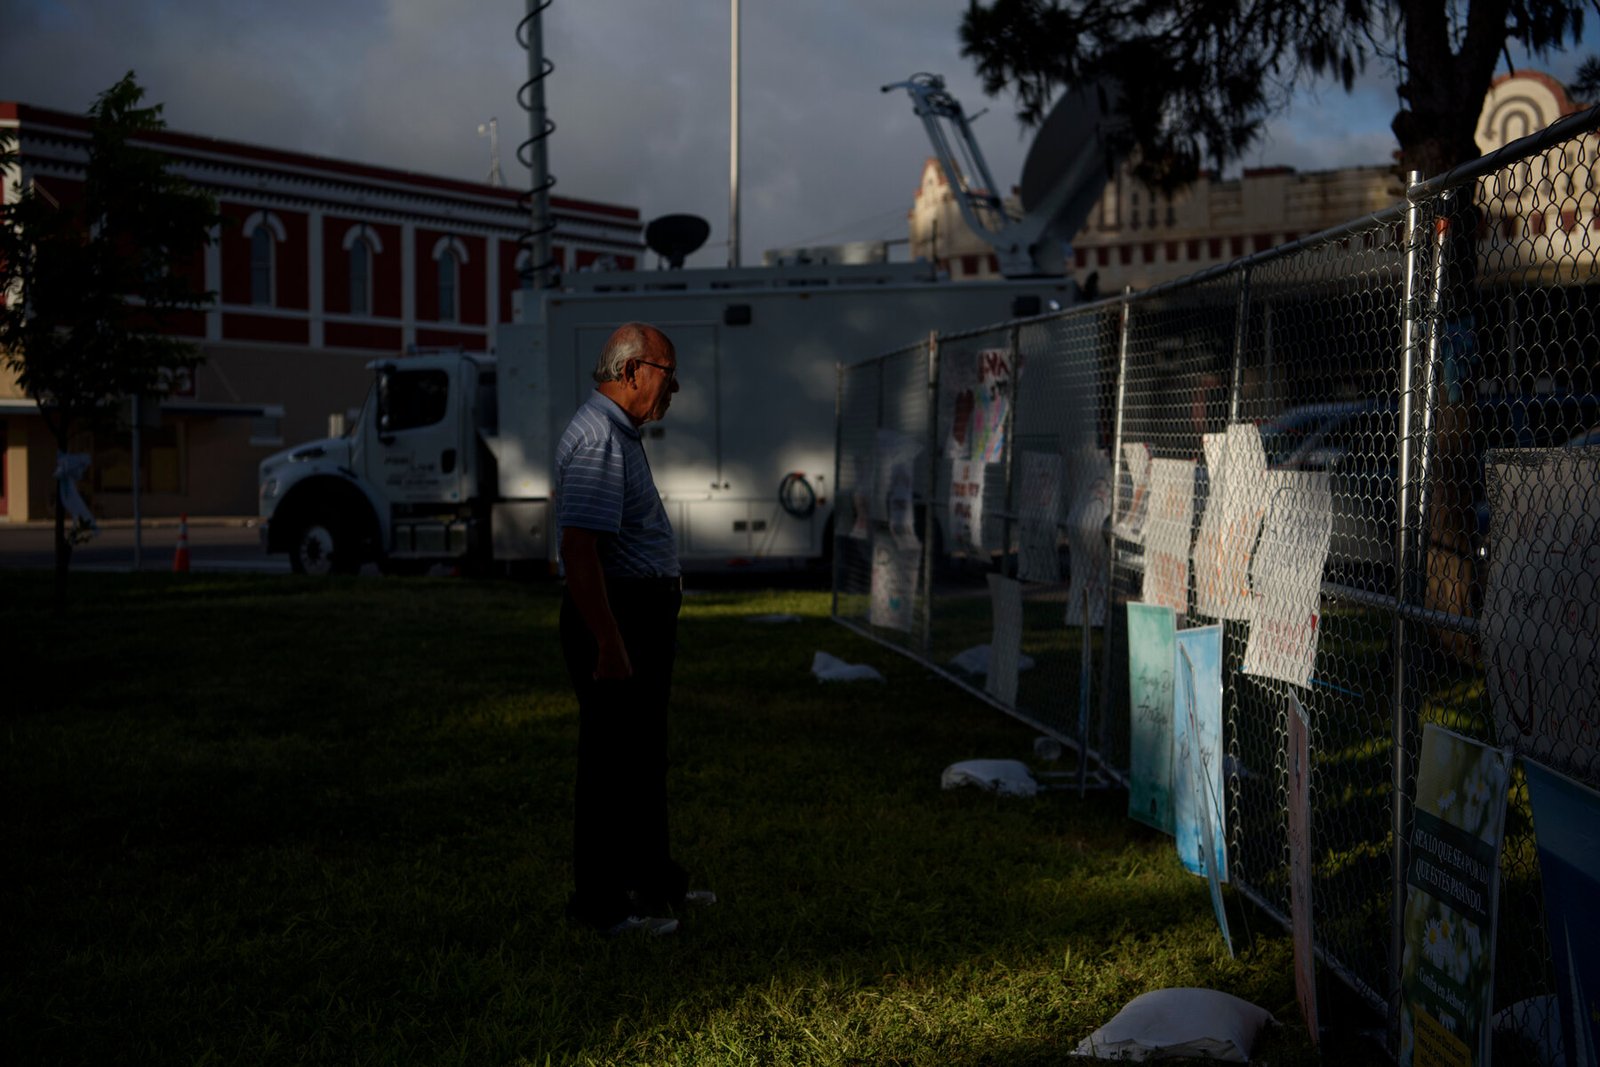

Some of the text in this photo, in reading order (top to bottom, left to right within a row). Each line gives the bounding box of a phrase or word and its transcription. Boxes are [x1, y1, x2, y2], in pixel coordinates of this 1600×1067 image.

[1414, 829, 1428, 852] SEA
[1428, 835, 1437, 854] LO
[1438, 840, 1453, 864] QUE
[1415, 857, 1430, 881] QUE
[1430, 865, 1450, 893] ESTÉS
